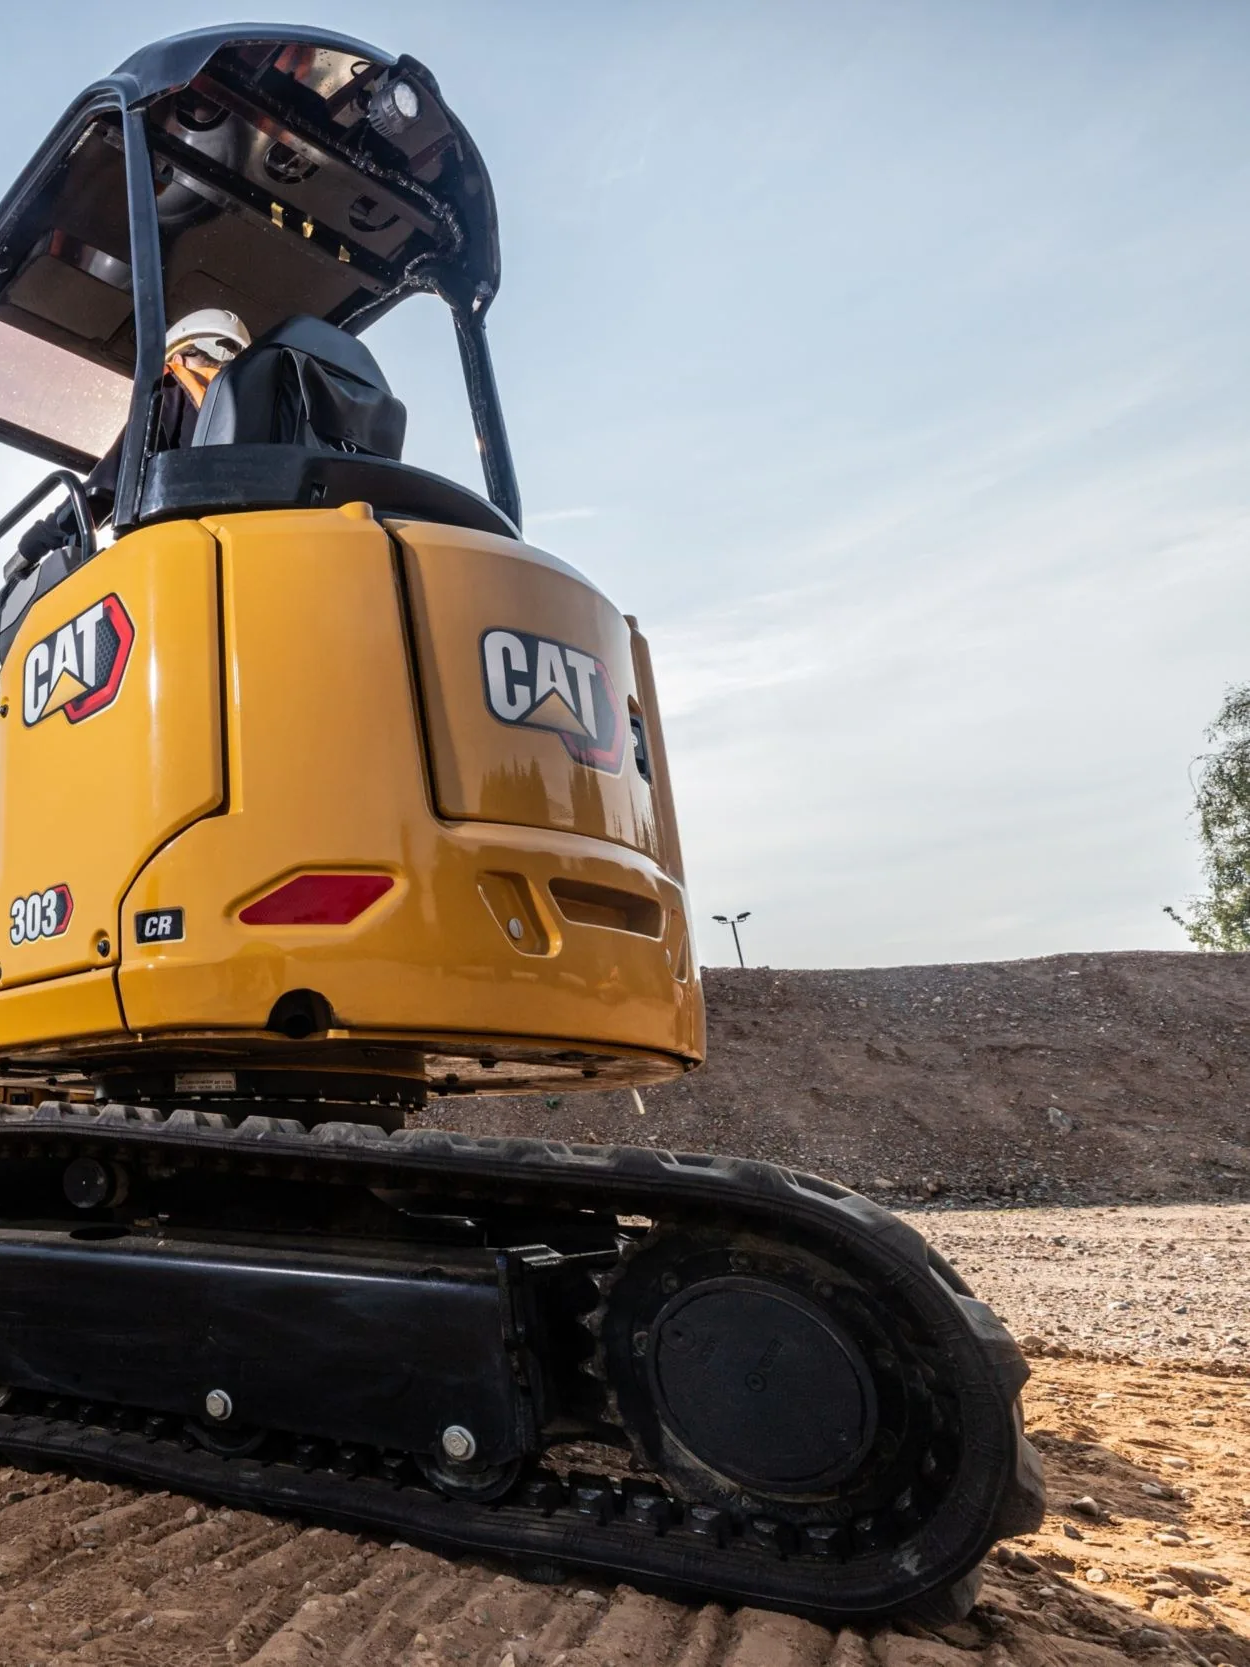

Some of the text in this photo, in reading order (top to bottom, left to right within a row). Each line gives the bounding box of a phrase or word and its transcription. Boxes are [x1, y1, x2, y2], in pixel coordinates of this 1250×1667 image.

[24, 601, 104, 724] CAT
[483, 630, 598, 740] CAT
[10, 889, 58, 944] 303
[144, 915, 173, 938] CR
